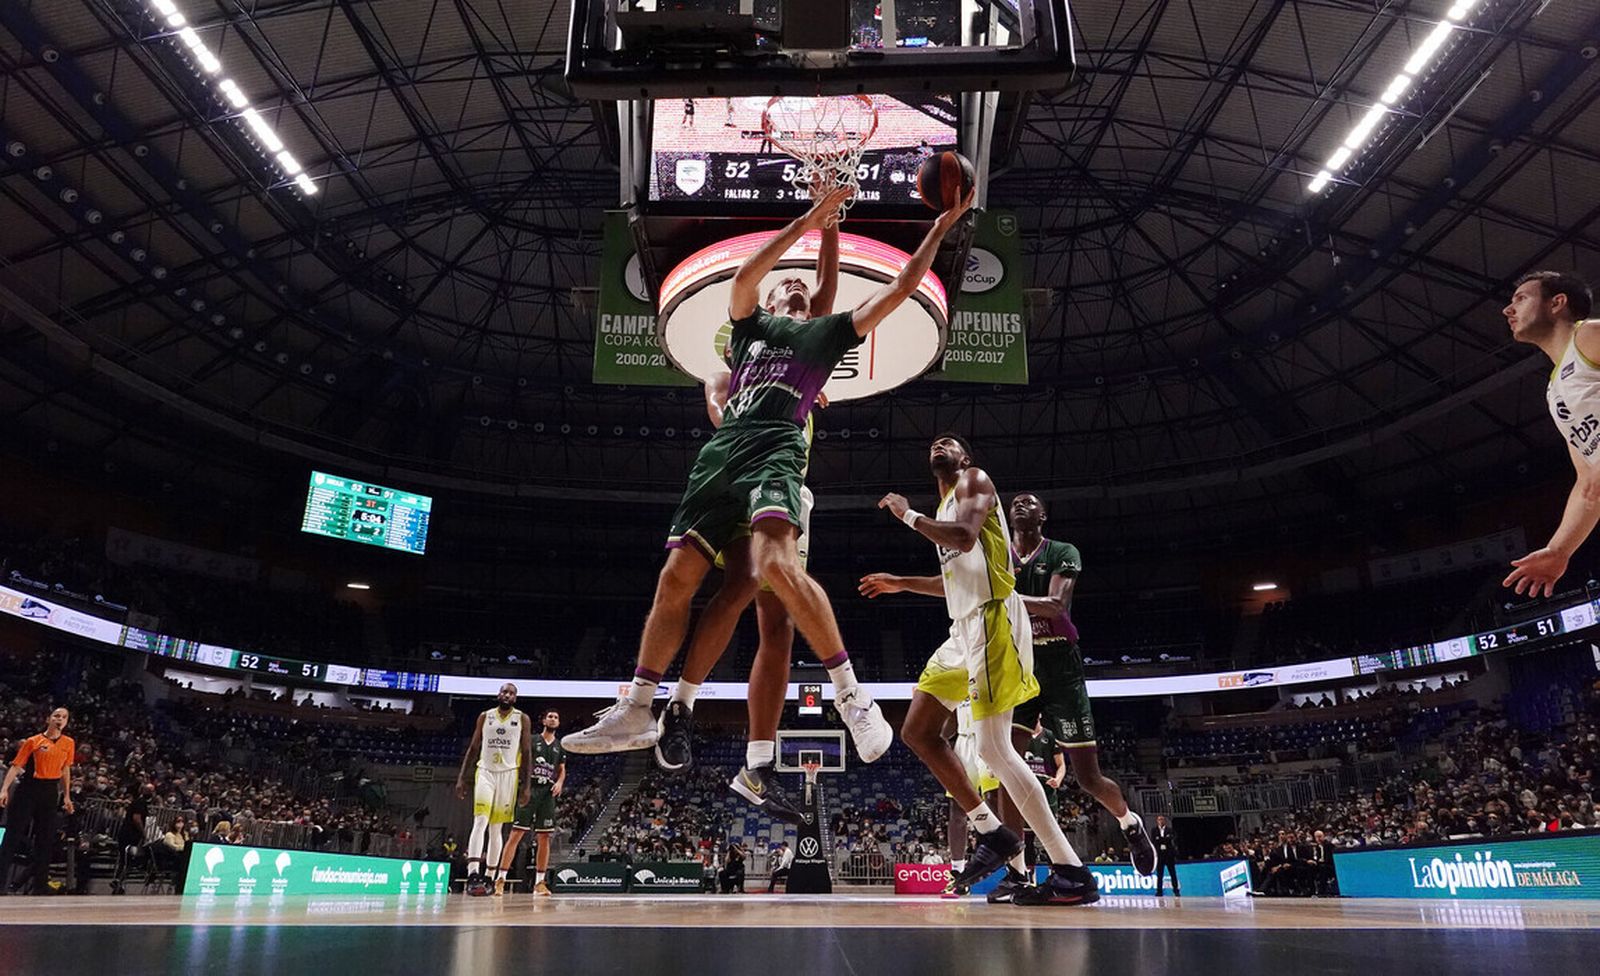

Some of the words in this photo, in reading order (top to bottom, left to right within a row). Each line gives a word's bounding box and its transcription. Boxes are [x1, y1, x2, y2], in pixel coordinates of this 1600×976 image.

[725, 161, 750, 179] 52
[856, 163, 880, 181] 51
[724, 188, 751, 199] FALTAS
[752, 189, 760, 199] 2
[776, 189, 784, 200] 3
[600, 313, 656, 335] CAMPE
[950, 311, 1021, 334] MPEONES
[603, 334, 642, 347] COPA
[947, 332, 1016, 348] UROCUP
[945, 350, 1005, 363] 2016/2017
[1536, 618, 1555, 636] 51
[1478, 633, 1499, 650] 52
[240, 654, 259, 669] 52
[302, 663, 319, 678] 51
[805, 694, 816, 708] 6
[575, 875, 602, 885] Unicaja
[602, 876, 623, 884] Banco
[653, 876, 679, 886] Unicaja
[679, 876, 700, 884] Banco
[897, 866, 953, 882] endes
